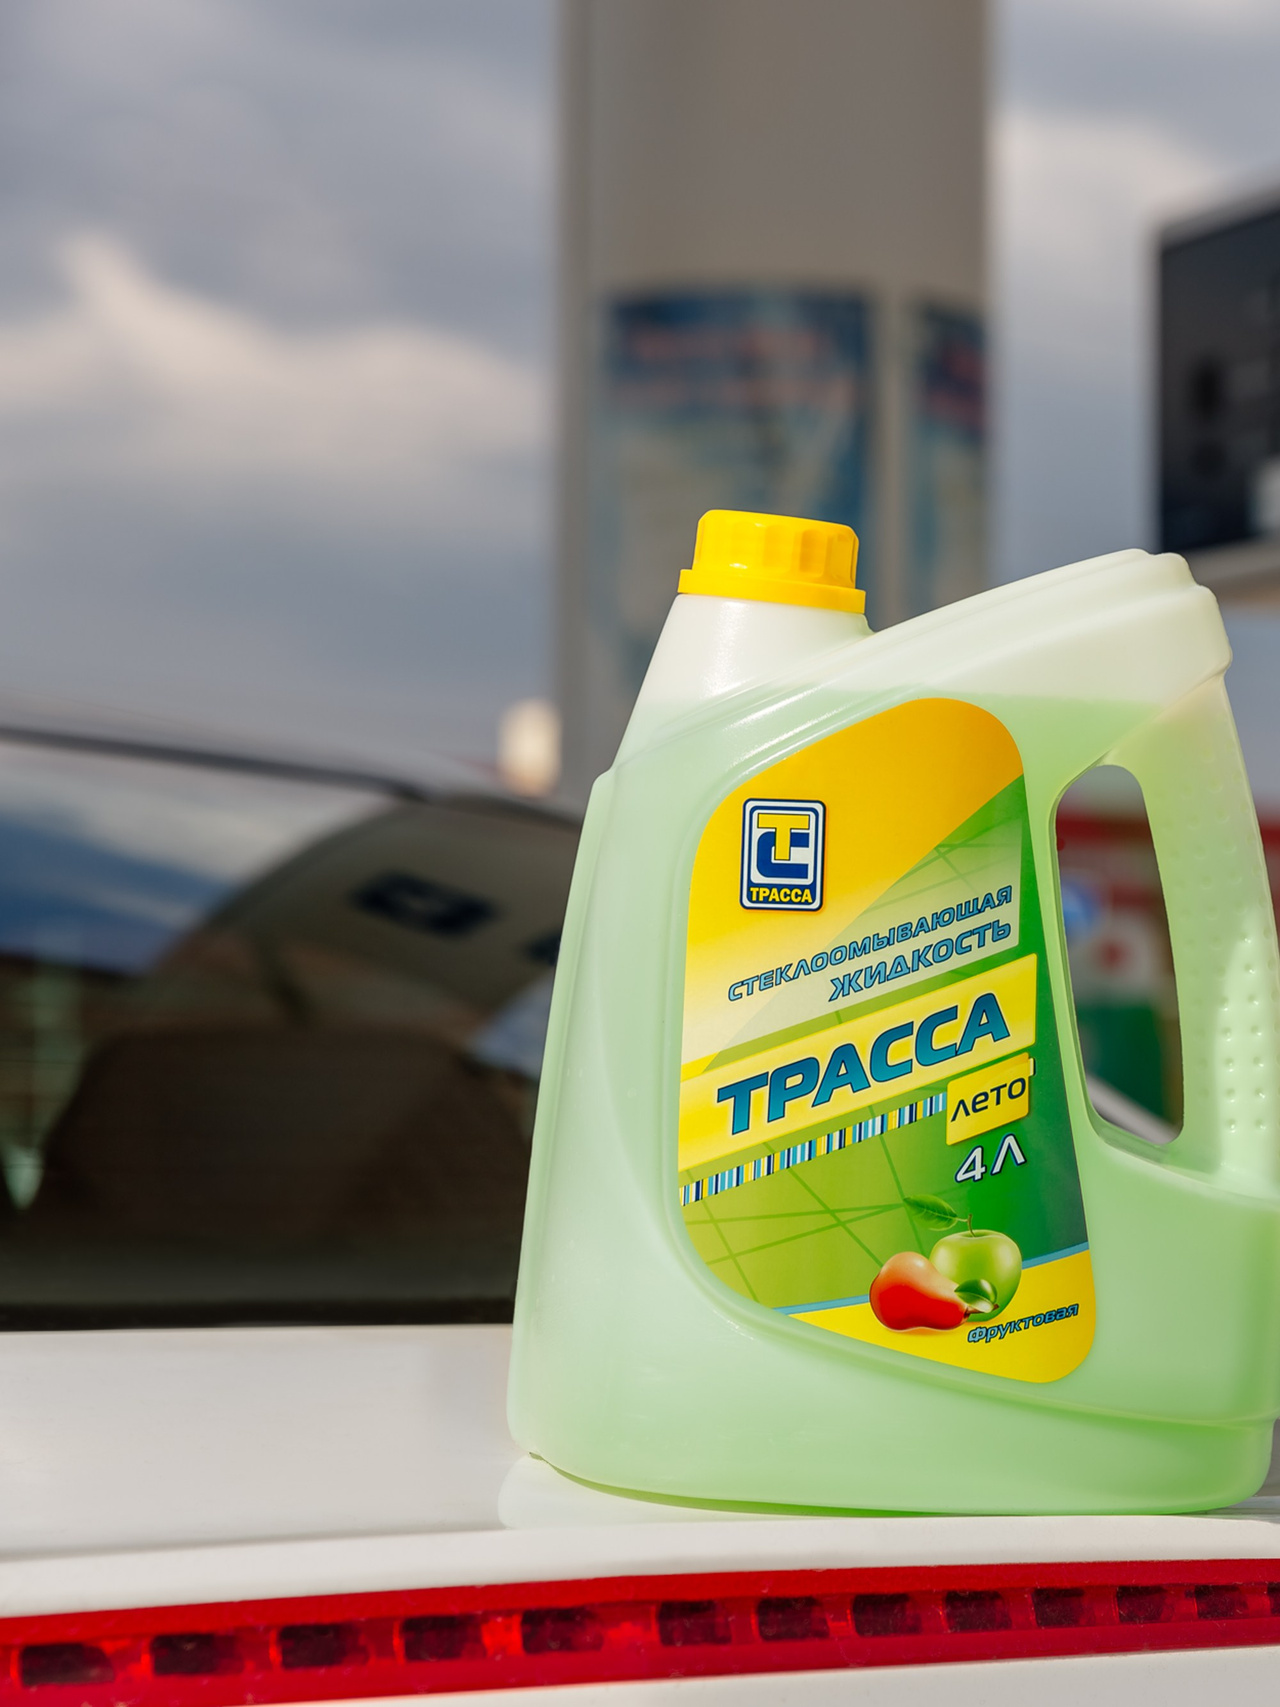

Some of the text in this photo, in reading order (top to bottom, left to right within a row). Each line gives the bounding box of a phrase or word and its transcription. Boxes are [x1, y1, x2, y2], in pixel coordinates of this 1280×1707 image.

[728, 885, 1012, 1001] СТЕКЛООМЫВАЮЩАЯ
[750, 887, 813, 903] ТРАССА
[828, 919, 1011, 1001] ЖИДКОСТЬ
[717, 992, 1010, 1135] ТРАССА
